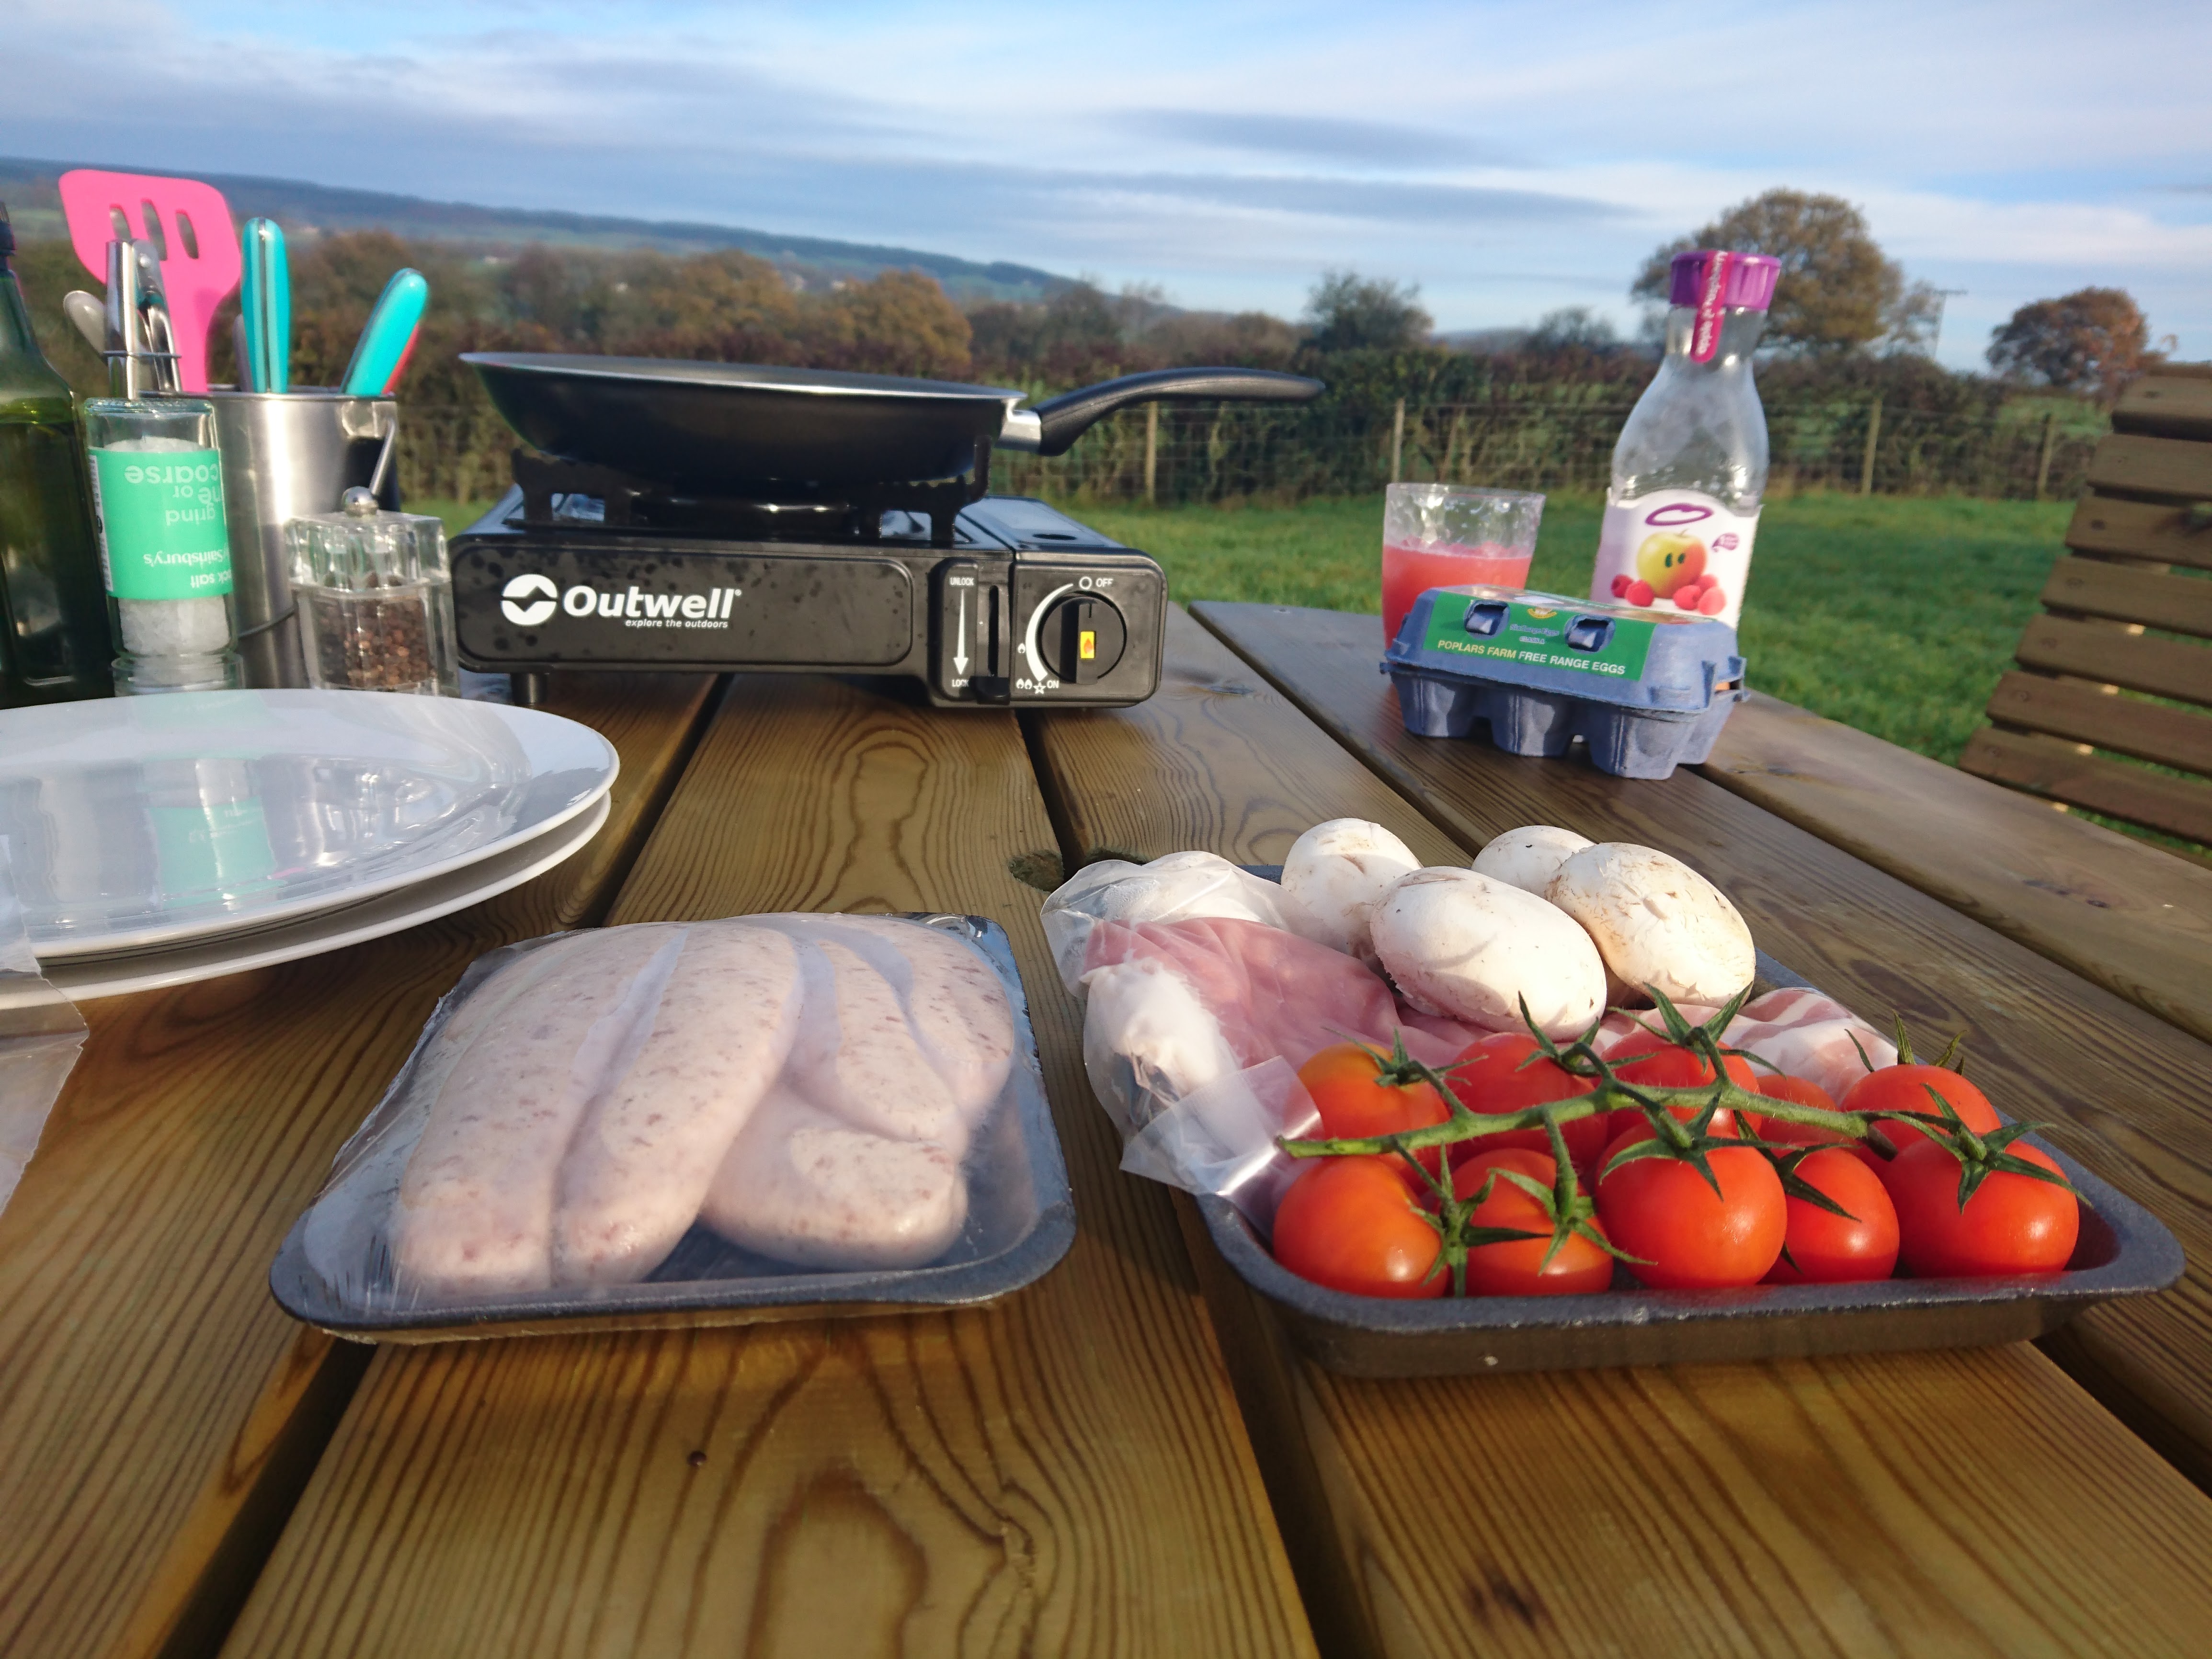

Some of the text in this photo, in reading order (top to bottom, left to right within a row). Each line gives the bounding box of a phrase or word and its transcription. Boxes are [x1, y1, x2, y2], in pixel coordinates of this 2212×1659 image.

[124, 463, 219, 484] coarse
[172, 485, 222, 504] ne or
[165, 502, 216, 526] grind
[143, 549, 223, 567] Sainsbury's
[190, 573, 215, 588] salt
[950, 577, 974, 586] UNLOCK
[1095, 578, 1114, 587] OFF
[562, 585, 735, 619] Outwell
[625, 619, 729, 629] explore the outdoors
[1437, 639, 1626, 675] POPLARS FARM FREE RANGE EGGS
[952, 679, 970, 687] LOCK
[1047, 680, 1060, 689] ON
